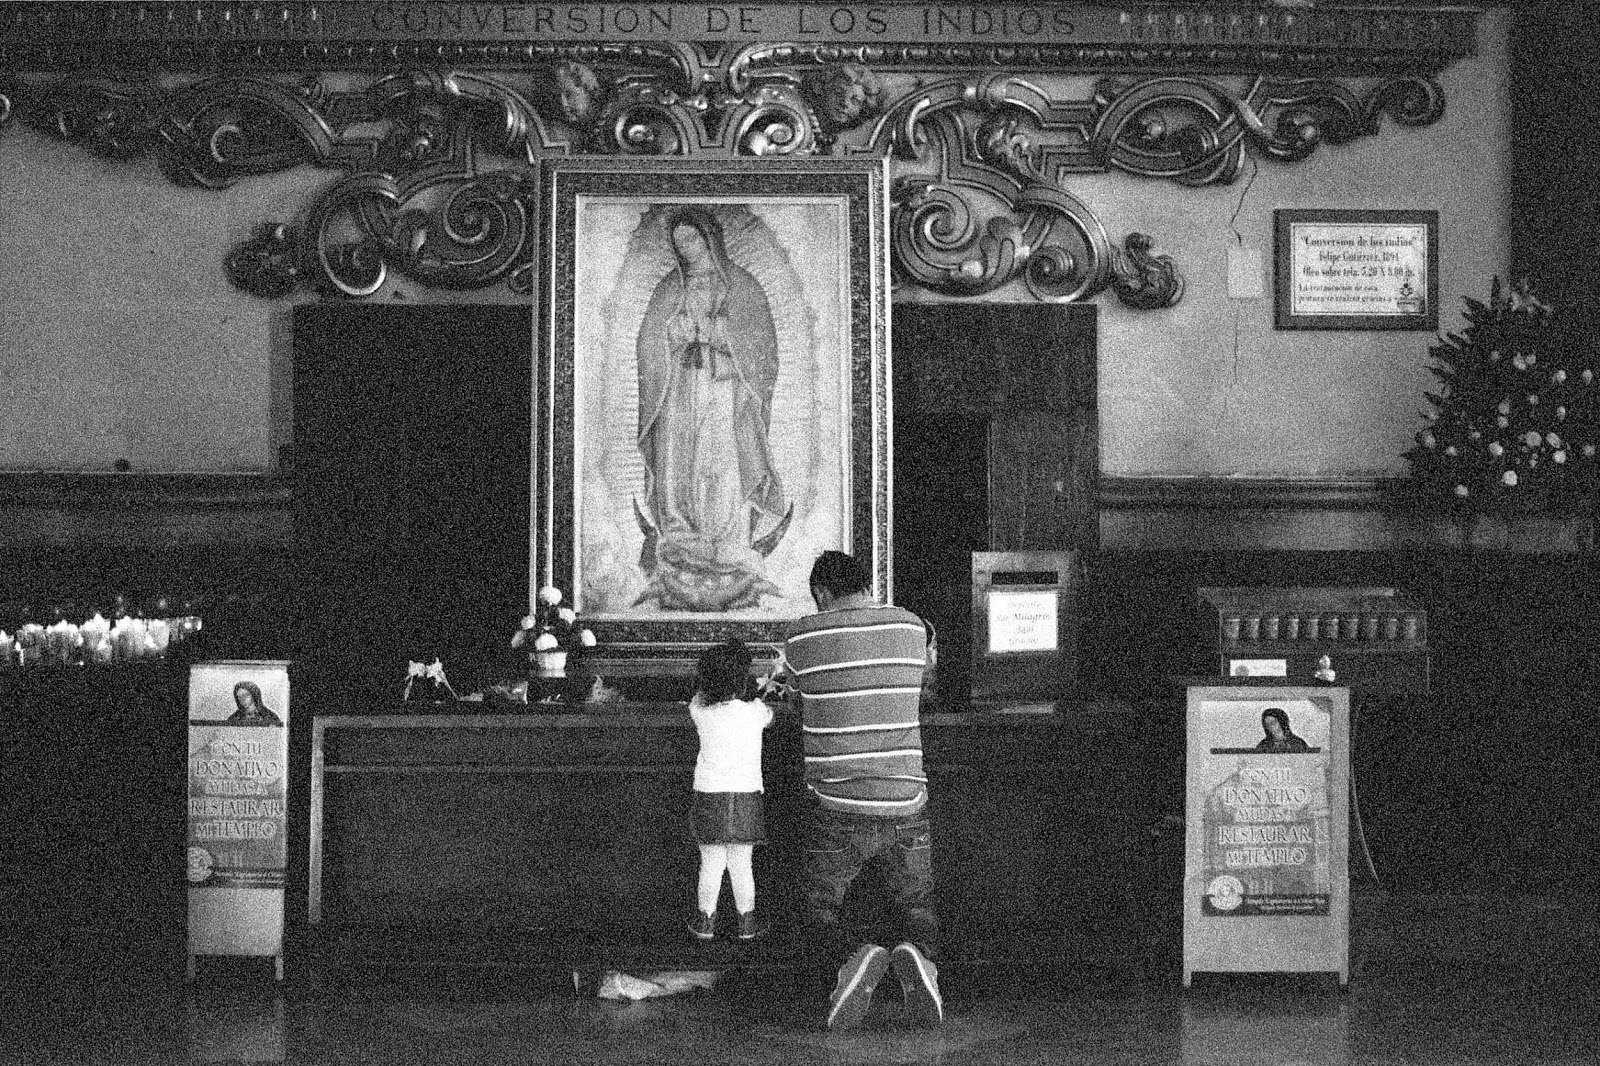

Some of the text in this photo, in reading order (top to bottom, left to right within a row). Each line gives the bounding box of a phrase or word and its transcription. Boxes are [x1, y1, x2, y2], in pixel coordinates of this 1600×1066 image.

[371, 7, 1075, 35] CONVERSION DE LOS INDIOS
[1357, 235, 1369, 247] de
[194, 760, 279, 777] DONATIVO
[1224, 787, 1307, 804] DONATIVO
[189, 799, 282, 816] RESTAURAR
[1220, 826, 1312, 843] RESTAURAR
[1243, 847, 1307, 865] TEMPLO
